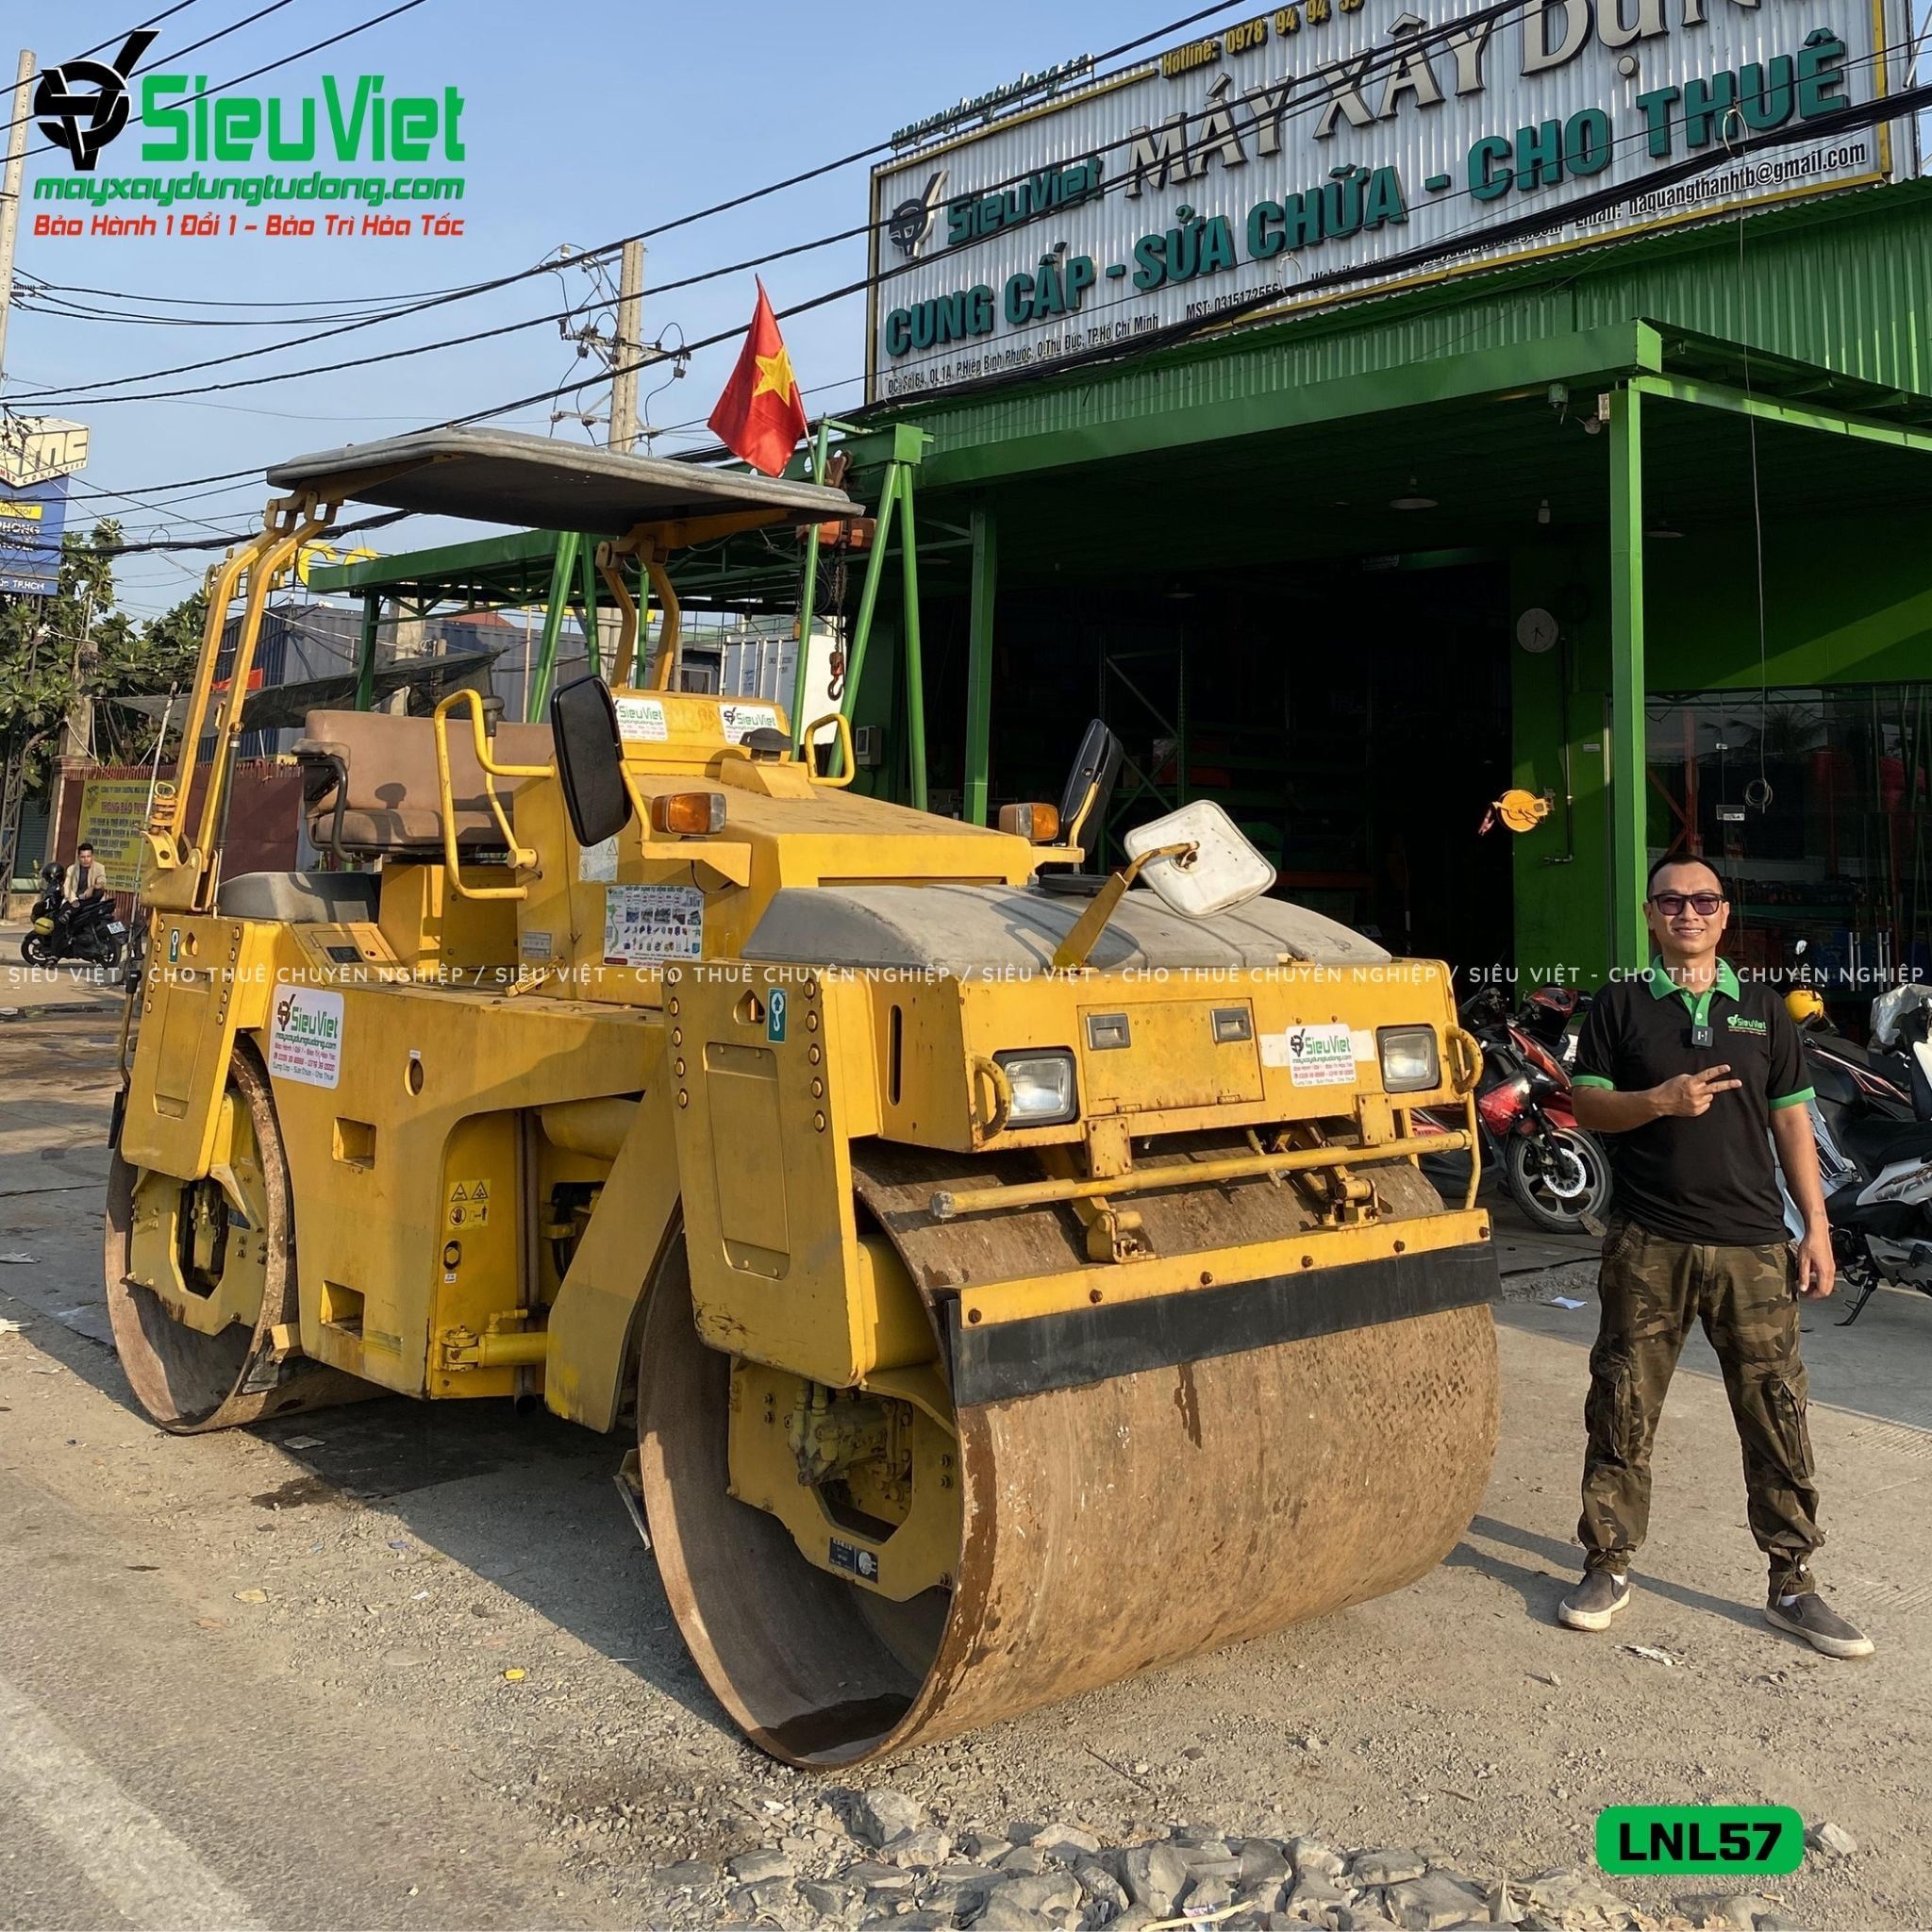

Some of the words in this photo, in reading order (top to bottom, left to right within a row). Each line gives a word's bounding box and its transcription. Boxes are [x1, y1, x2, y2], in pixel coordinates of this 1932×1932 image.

[1162, 40, 1222, 79] Hotline:
[1226, 17, 1268, 57] 0978
[1275, 6, 1300, 38] 94
[1124, 73, 1295, 198] MÁY
[1312, 12, 1496, 140] XÂY
[886, 284, 994, 357] CUNG
[1005, 242, 1097, 325] CẤP
[1133, 205, 1237, 291] SỬA
[1247, 163, 1409, 260] CHỮA
[1467, 108, 1612, 202] CHO
[1637, 27, 1853, 158] THUÊ
[947, 156, 1105, 246] SieuViet
[1135, 314, 1159, 333] Minh
[291, 1006, 339, 1039] SieuViet
[1305, 1035, 1351, 1056] SieuViet
